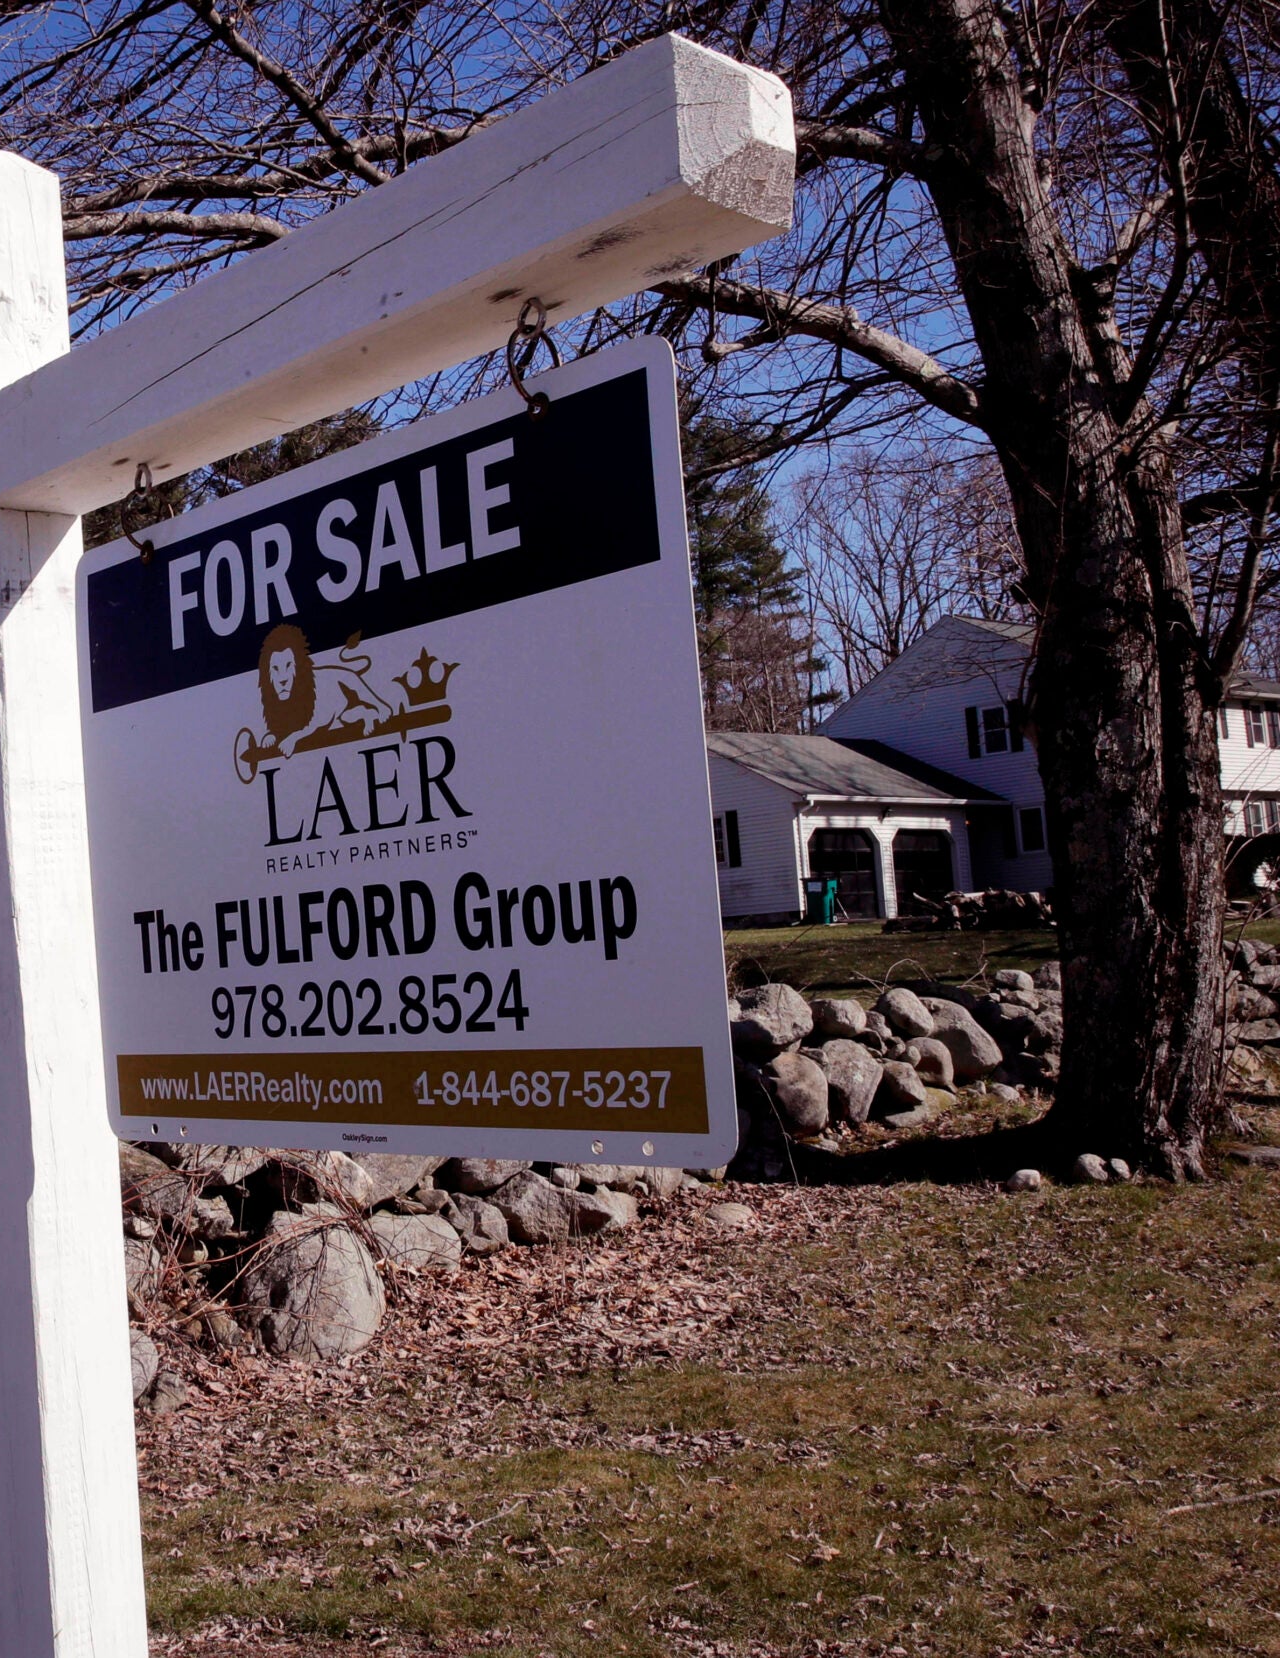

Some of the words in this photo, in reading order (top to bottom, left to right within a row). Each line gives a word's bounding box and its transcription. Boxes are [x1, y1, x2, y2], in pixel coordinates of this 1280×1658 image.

[169, 522, 298, 651] FOR
[315, 437, 521, 603] SALE
[260, 736, 473, 848] LAER
[266, 850, 339, 874] REALTY
[133, 909, 205, 974] The
[215, 879, 437, 969] FULFORD
[453, 871, 638, 961] Group
[211, 968, 530, 1040] 978.202.8524
[140, 1071, 383, 1111] www.LAERRealty.com
[415, 1070, 672, 1109] 1-844-687-5237
[341, 1133, 388, 1144] OakleySign.com
